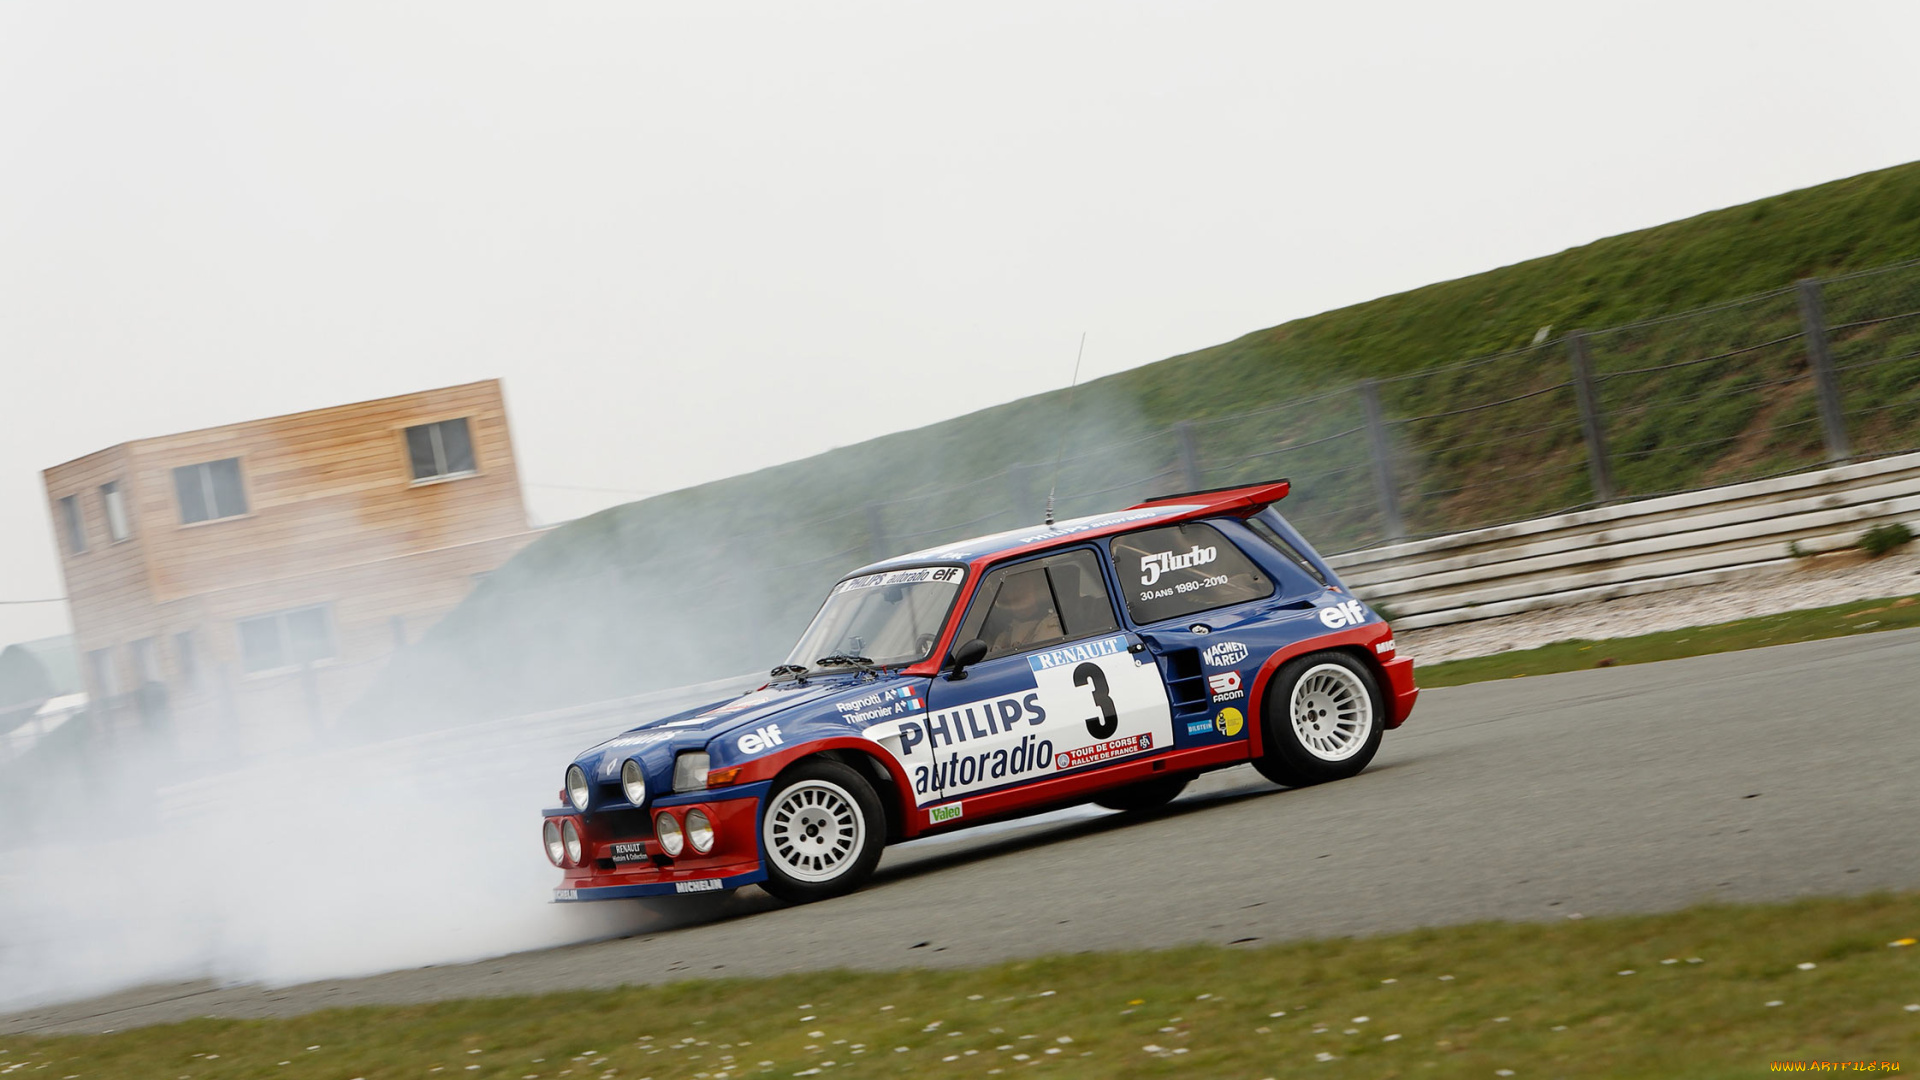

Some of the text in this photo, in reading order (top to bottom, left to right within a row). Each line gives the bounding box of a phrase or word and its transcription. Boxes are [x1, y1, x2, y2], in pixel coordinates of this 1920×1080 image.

[932, 568, 958, 581] elf
[1140, 574, 1229, 601] 30 ANS 1980-2010
[1320, 600, 1365, 628] elf
[1037, 638, 1119, 670] RENAULT
[836, 693, 882, 713] Ragnotti
[1072, 662, 1119, 740] 3
[1212, 690, 1245, 704] FACOM
[842, 706, 893, 725] Thimonier
[898, 692, 1046, 756] PHILIPS
[738, 724, 784, 754] elf
[1070, 737, 1137, 758] TOUR DE CORSE
[915, 734, 1053, 795] autoradio
[1071, 756, 1099, 766] RALLYE
[1111, 746, 1139, 757] FRANCE
[931, 806, 961, 822] Valeo
[616, 843, 641, 854] RENAULT
[676, 878, 723, 894] MICHELIN
